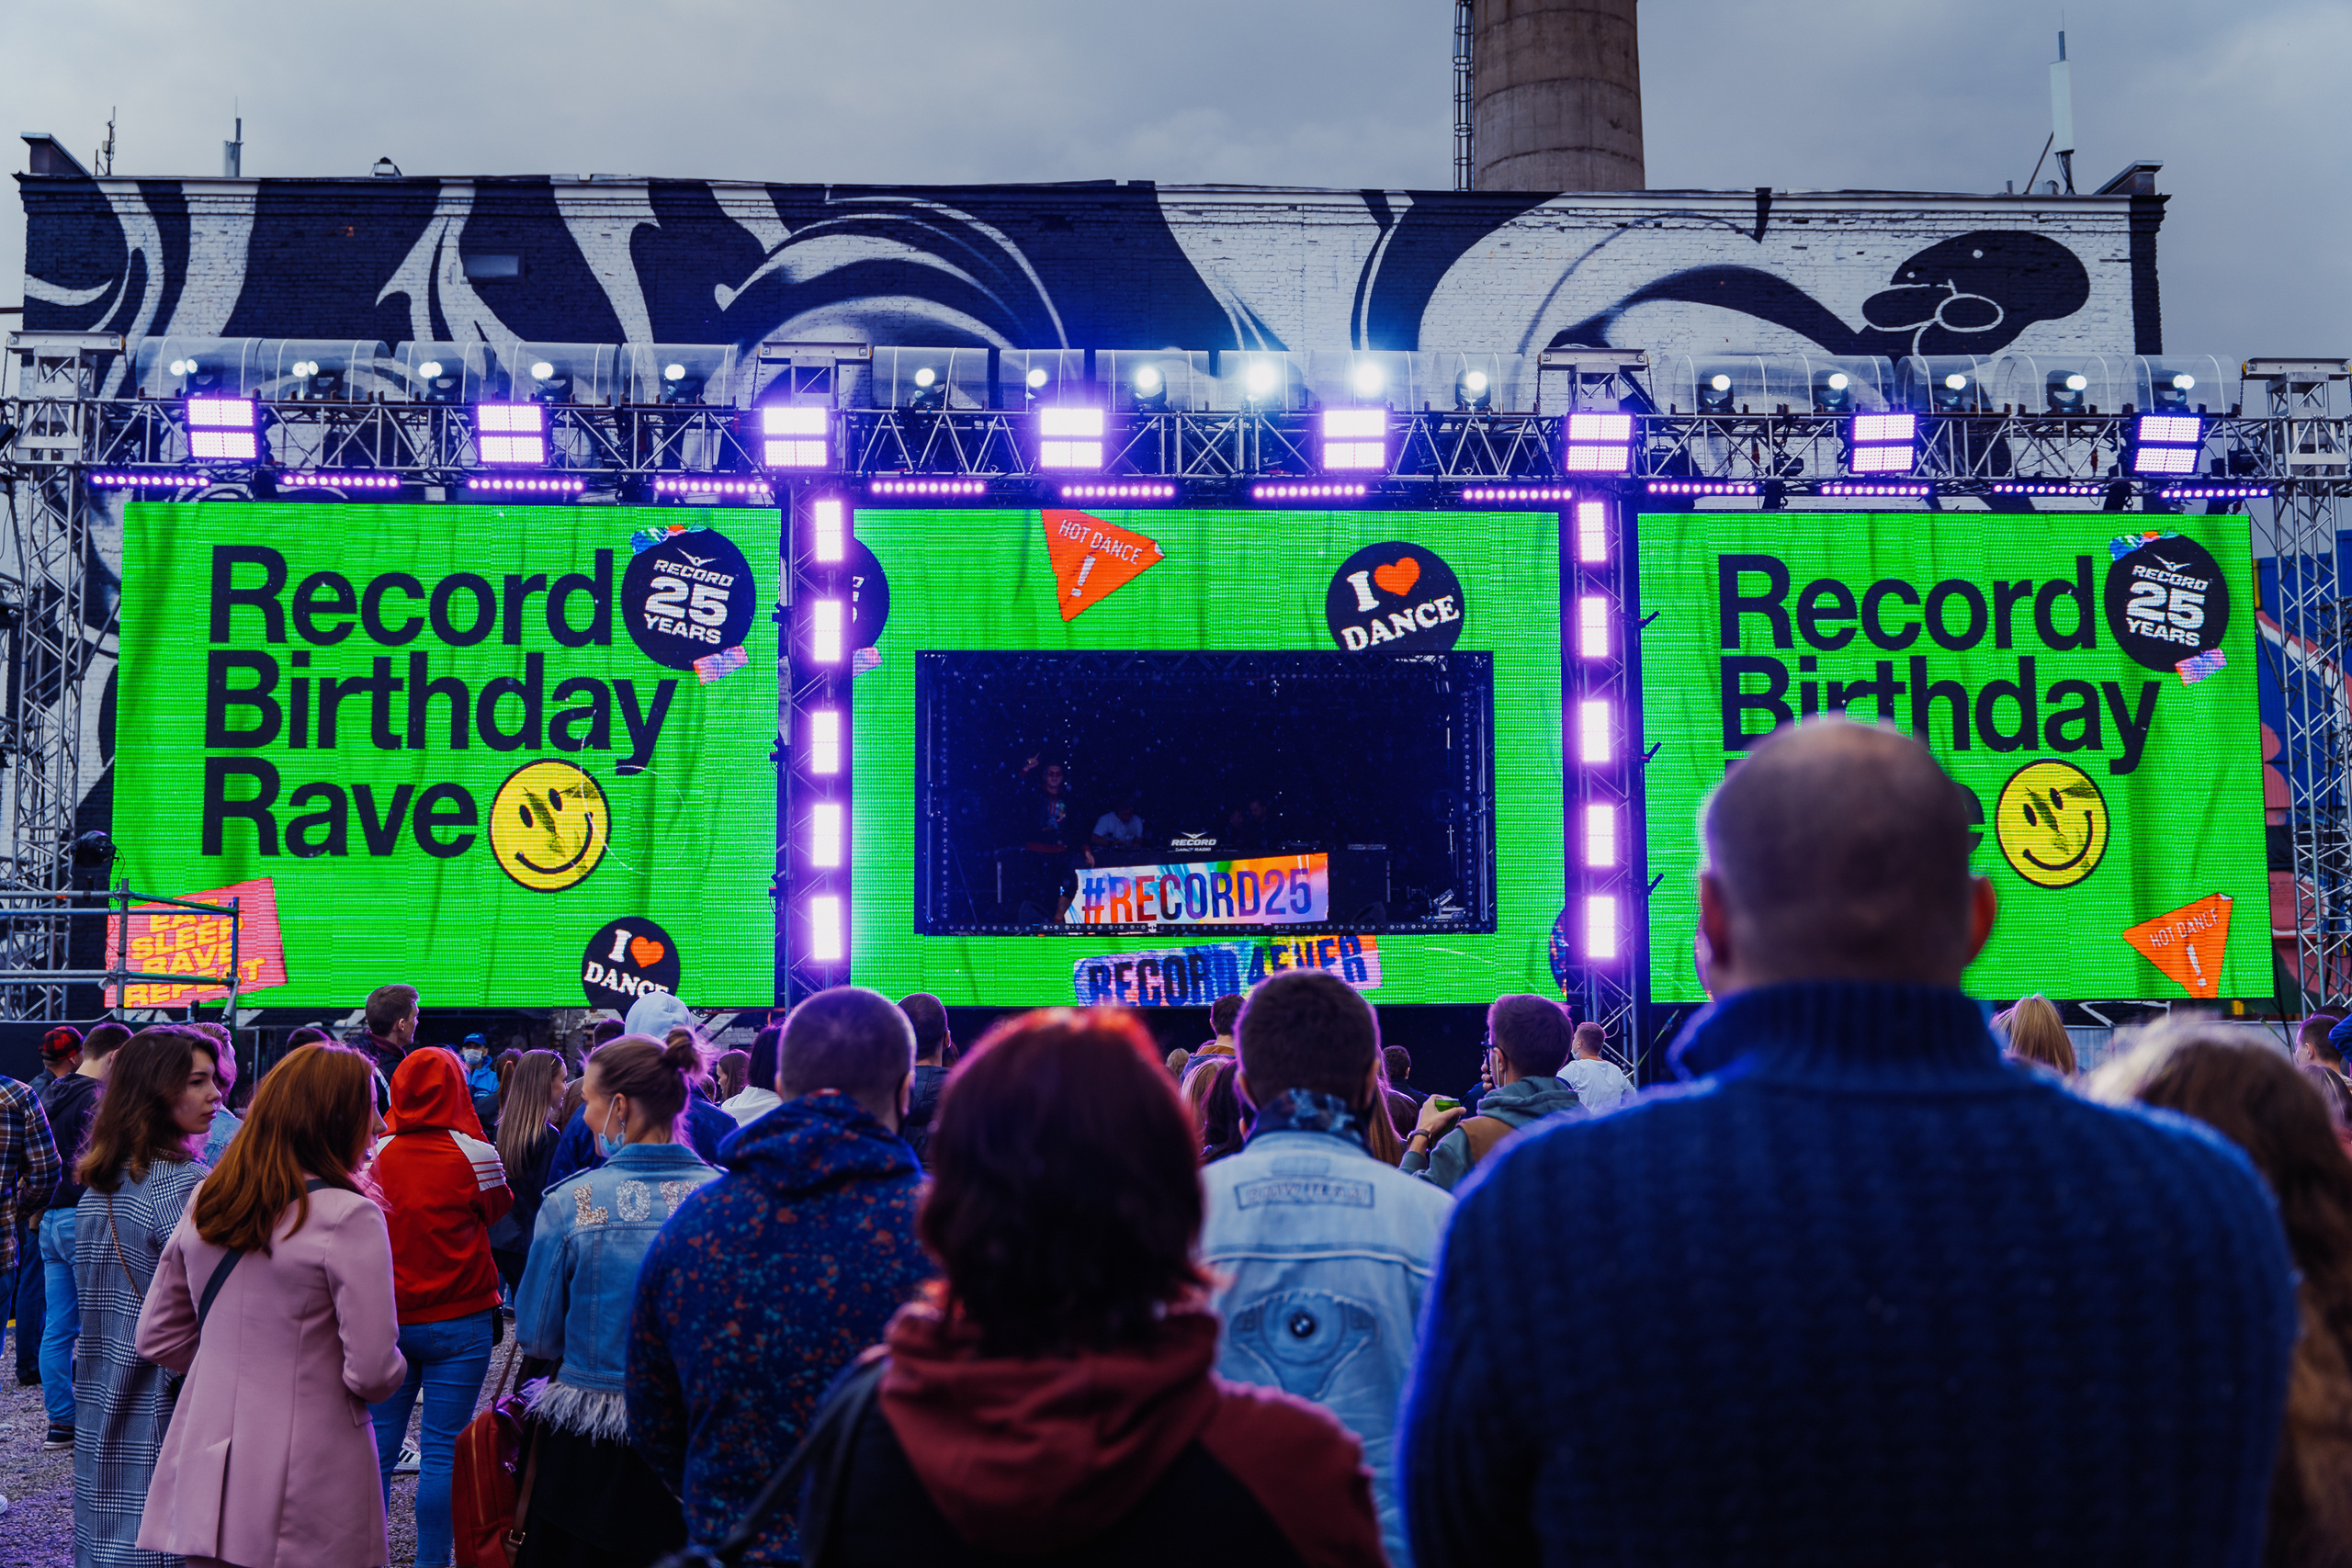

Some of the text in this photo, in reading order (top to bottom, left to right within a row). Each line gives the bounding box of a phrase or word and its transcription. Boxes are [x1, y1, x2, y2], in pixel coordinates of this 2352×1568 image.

[1057, 519, 1143, 565] HOT DANCE
[209, 545, 614, 648] Record
[653, 558, 735, 588] RECORD
[1346, 570, 1380, 613] I
[2132, 564, 2209, 592] RECORD
[645, 576, 730, 626] 25
[1340, 594, 1461, 652] DANCE
[1718, 554, 2097, 650] Record
[2126, 581, 2206, 630] 25
[643, 613, 722, 645] YEARS
[2125, 616, 2201, 648] YEARS
[203, 650, 679, 776] Birthday
[1720, 655, 2162, 775] Birthday
[201, 756, 479, 859] Rave
[1082, 868, 1313, 923] #RECORD25
[130, 917, 244, 960] SLEEP
[607, 929, 632, 963] I
[2150, 908, 2221, 950] HOT DANCE
[142, 941, 233, 976] RAVE
[1088, 950, 1241, 1007] RECORD
